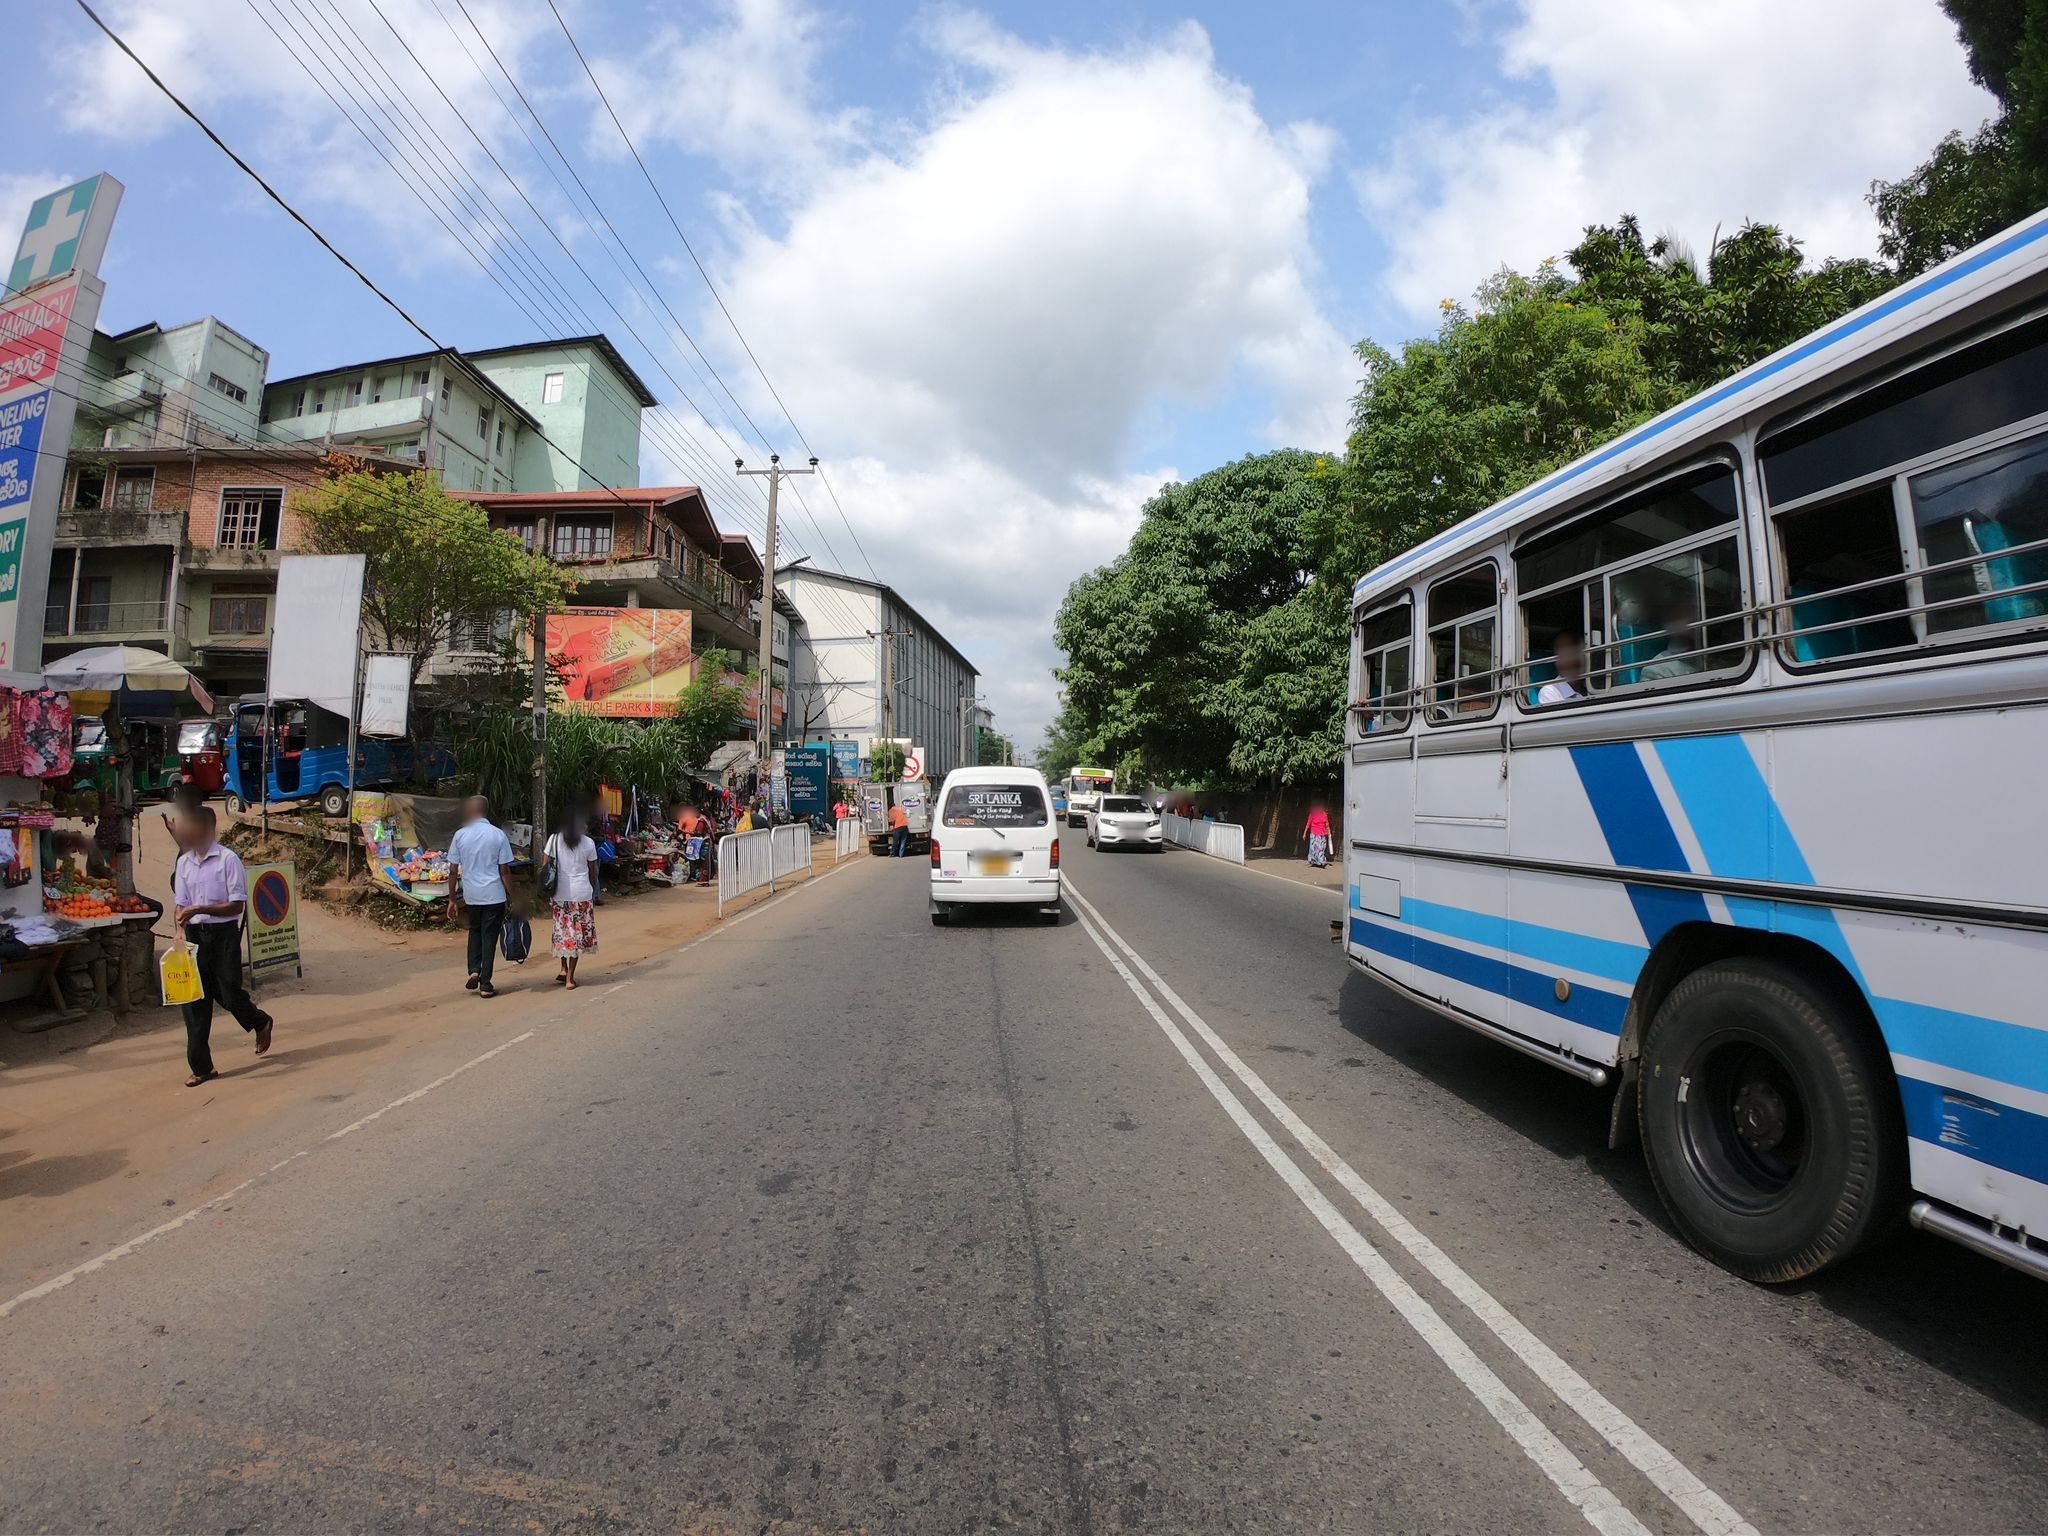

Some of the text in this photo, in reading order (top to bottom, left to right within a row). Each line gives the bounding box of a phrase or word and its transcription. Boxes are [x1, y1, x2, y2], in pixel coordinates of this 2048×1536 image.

[589, 640, 637, 662] CRACKER
[570, 700, 612, 712] VEHICLE
[615, 700, 642, 712] PARK
[644, 700, 652, 712] &
[968, 794, 1022, 804] SRI LANKA
[986, 806, 998, 814] the
